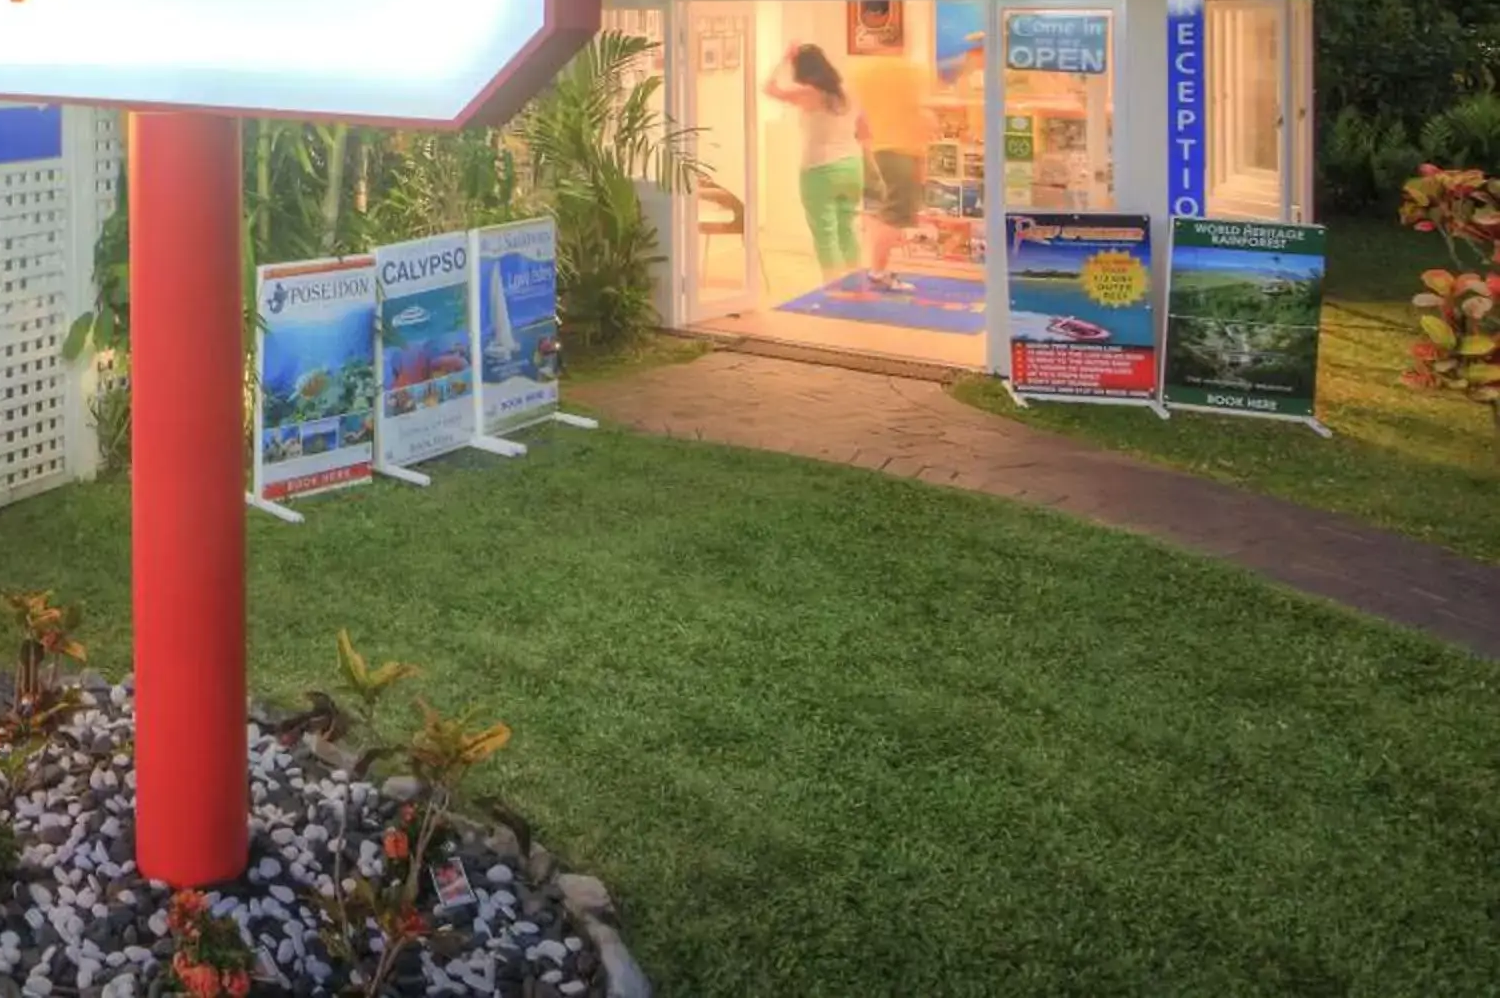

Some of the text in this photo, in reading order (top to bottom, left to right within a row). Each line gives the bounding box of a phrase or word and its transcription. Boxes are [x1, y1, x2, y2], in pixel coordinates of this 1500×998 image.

[1012, 17, 1076, 37] Come
[1008, 46, 1105, 72] OPEN
[1194, 223, 1305, 240] WORLD HERITAGE
[1211, 235, 1287, 249] RAINFOREST
[381, 246, 467, 286] CALYPSO
[288, 277, 370, 305] POSEIDON
[1207, 394, 1277, 411] BOOK HERE
